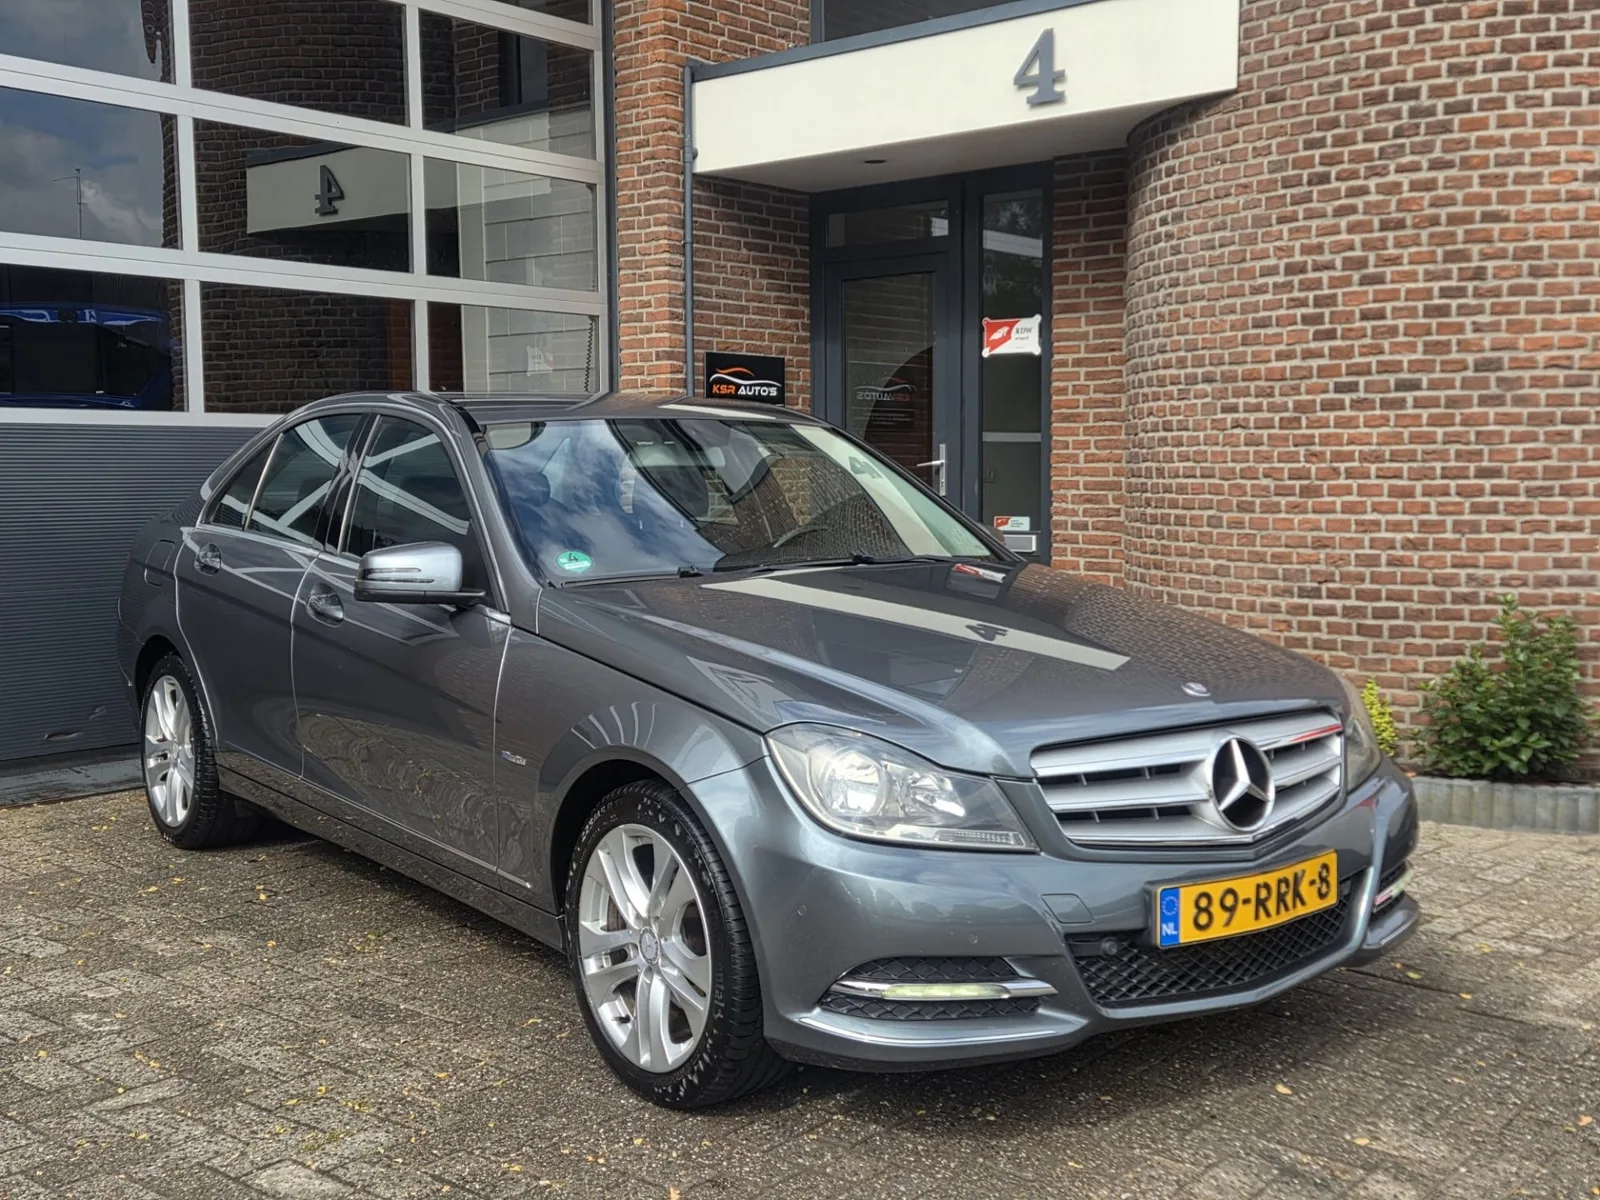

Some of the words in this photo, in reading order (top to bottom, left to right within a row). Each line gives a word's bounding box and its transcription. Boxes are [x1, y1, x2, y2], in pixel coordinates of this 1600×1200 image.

[1013, 28, 1066, 105] 4
[712, 384, 736, 395] KSR
[737, 385, 778, 396] AUTO'S
[568, 552, 579, 562] 4
[1192, 862, 1331, 932] 89-RRK-8
[1161, 921, 1178, 937] NL
